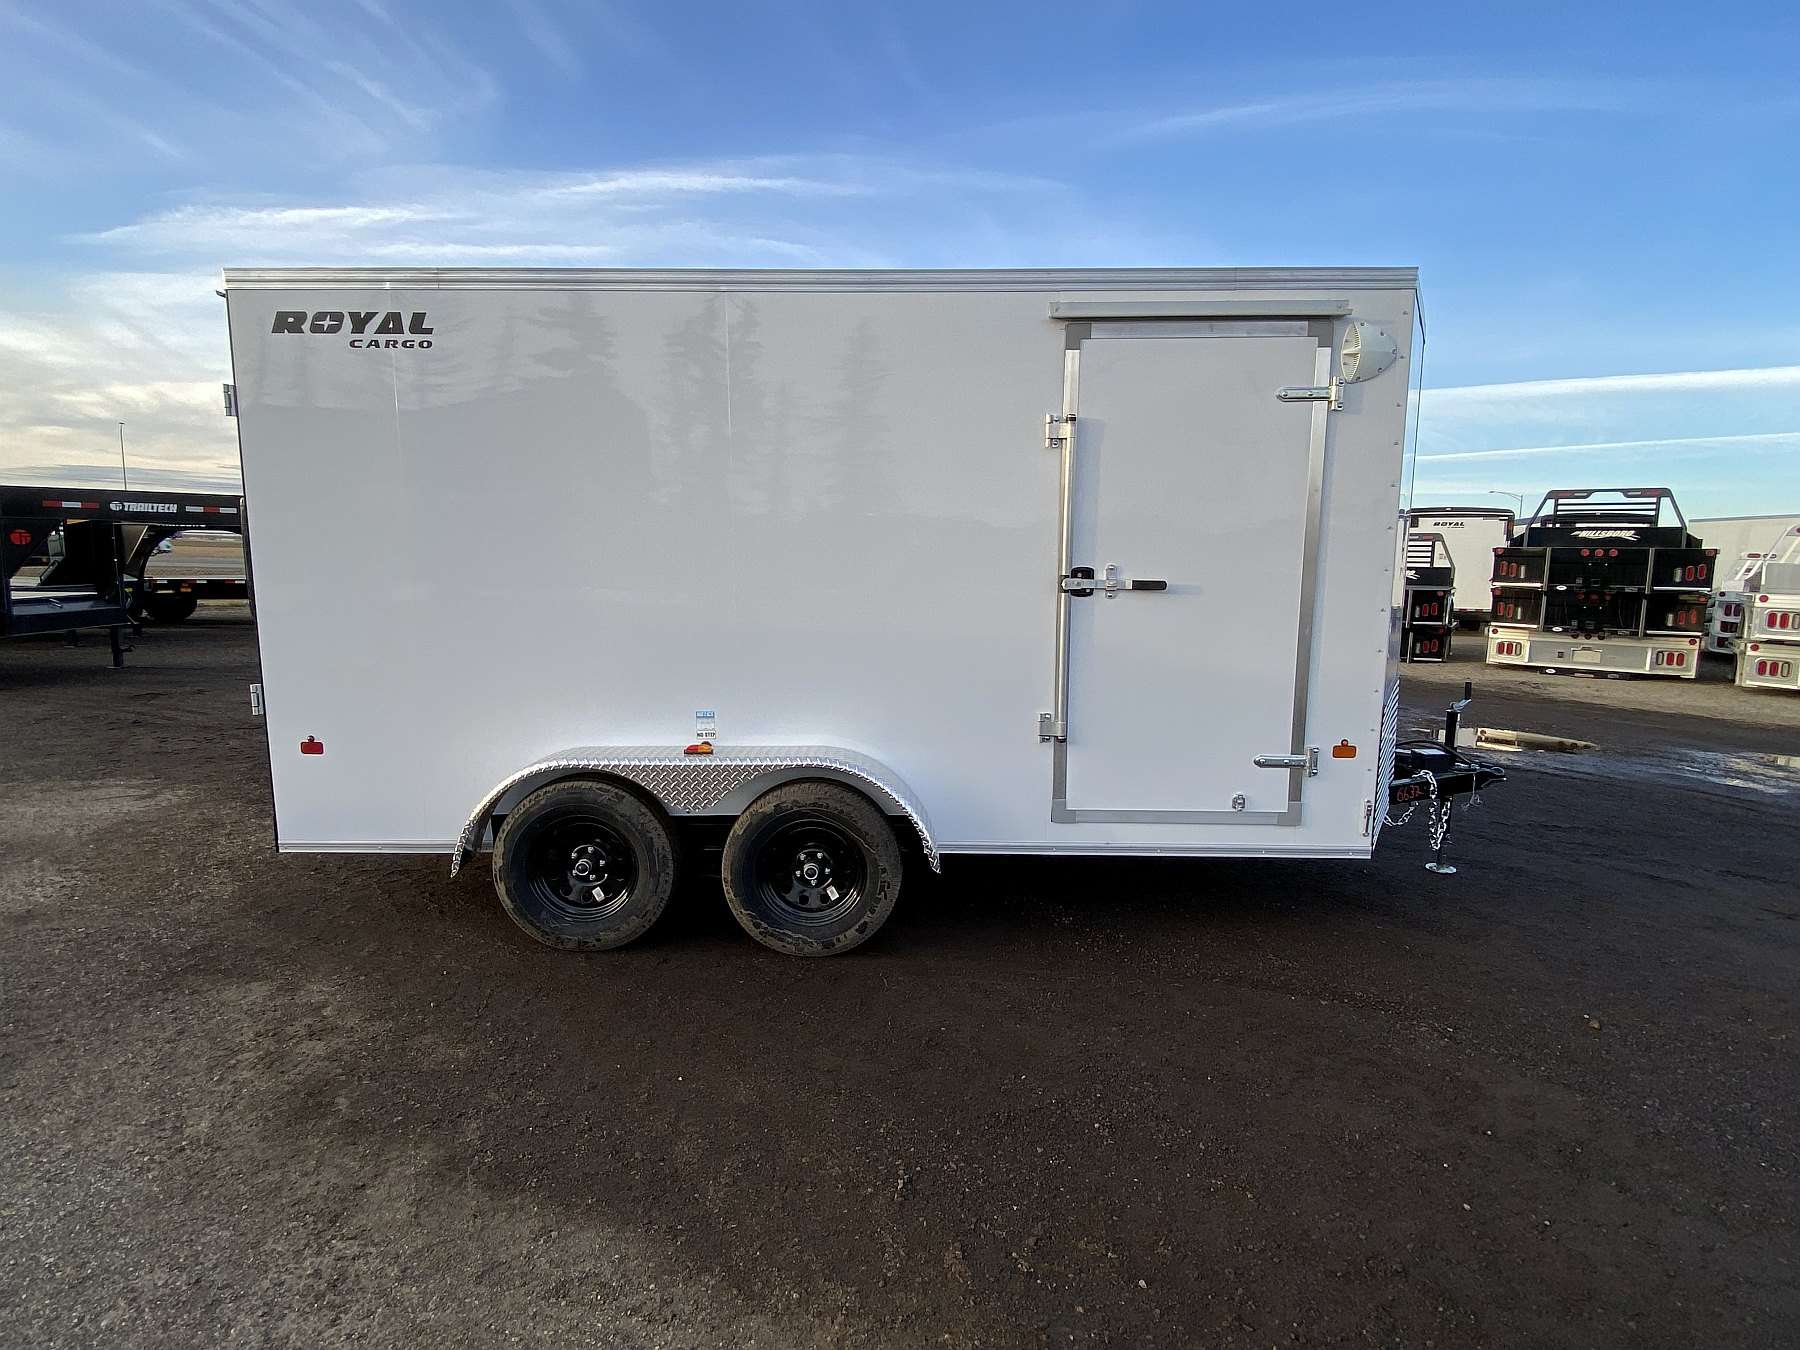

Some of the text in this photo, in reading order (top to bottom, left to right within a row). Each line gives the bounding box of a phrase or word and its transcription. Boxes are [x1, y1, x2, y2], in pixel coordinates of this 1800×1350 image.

[271, 311, 434, 334] ROYAL
[349, 339, 433, 349] CARGO
[123, 502, 177, 513] TRAILTECH
[1576, 530, 1638, 539] HILLSBORO
